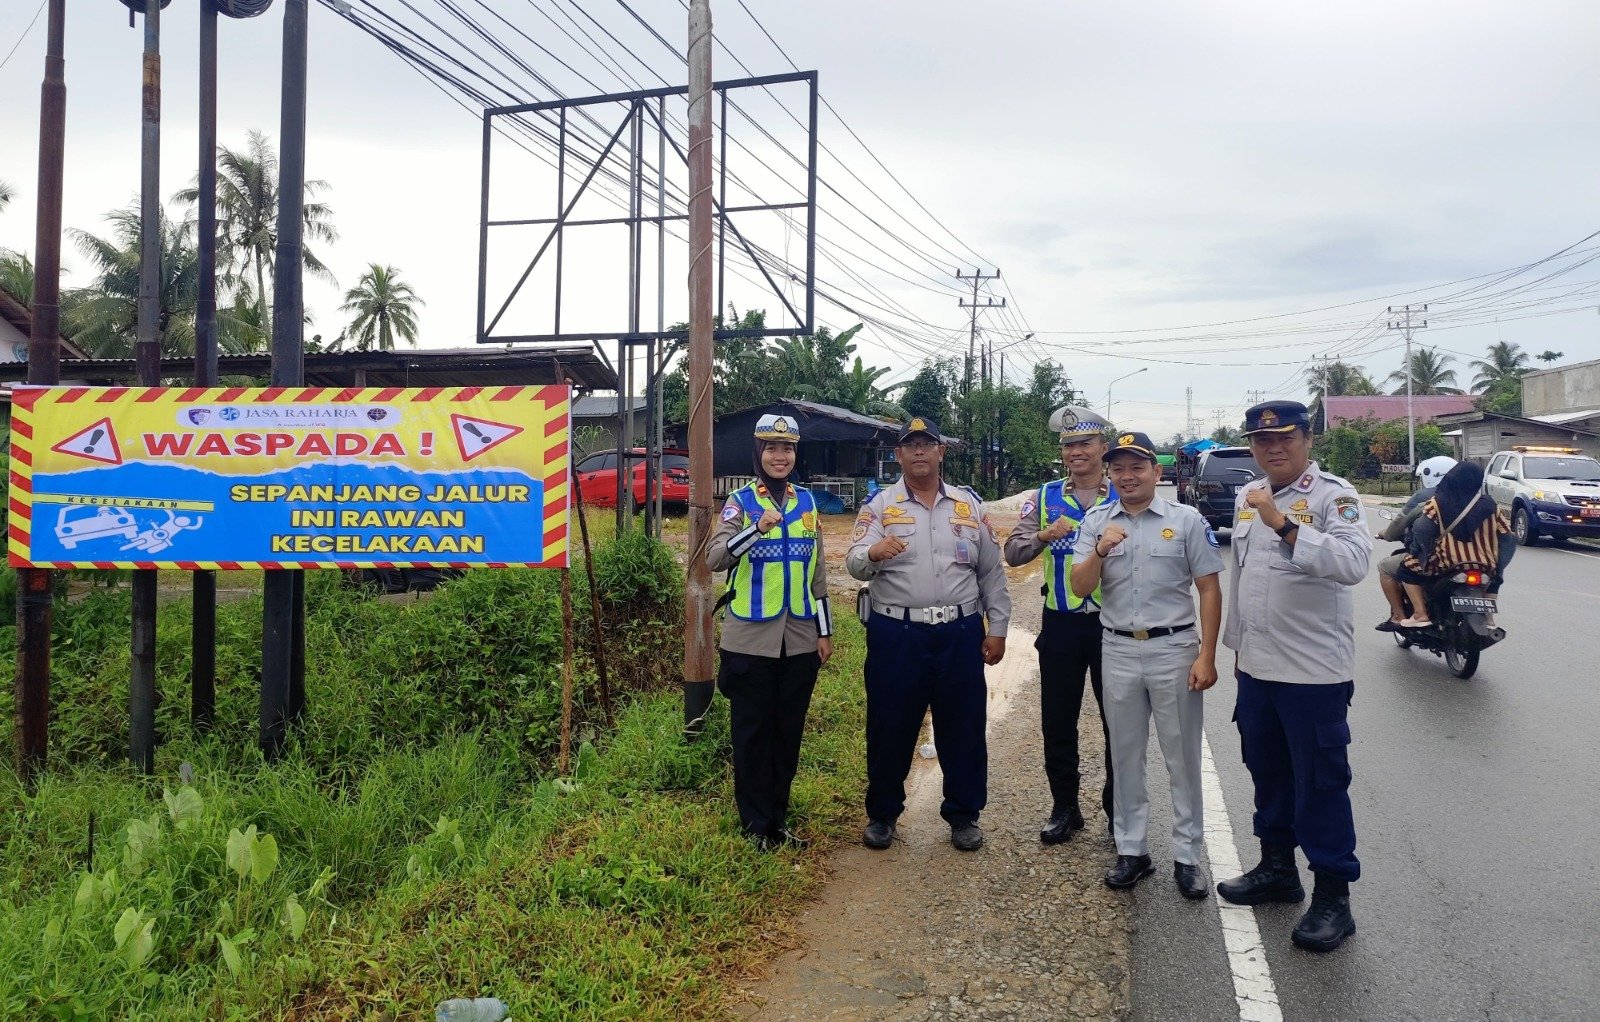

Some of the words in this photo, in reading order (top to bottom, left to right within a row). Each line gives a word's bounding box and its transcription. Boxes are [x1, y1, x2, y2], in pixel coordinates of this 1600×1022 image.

[245, 408, 280, 418] JASA
[285, 408, 358, 418] RAHARJA
[142, 433, 406, 456] WASPADA
[67, 496, 178, 509] KECELAKAAN
[230, 484, 421, 503] SEPANJANG
[426, 484, 530, 503] JALUR
[290, 509, 335, 528] INI
[340, 509, 465, 529] RAWAN
[271, 535, 485, 553] KECELAKAAN
